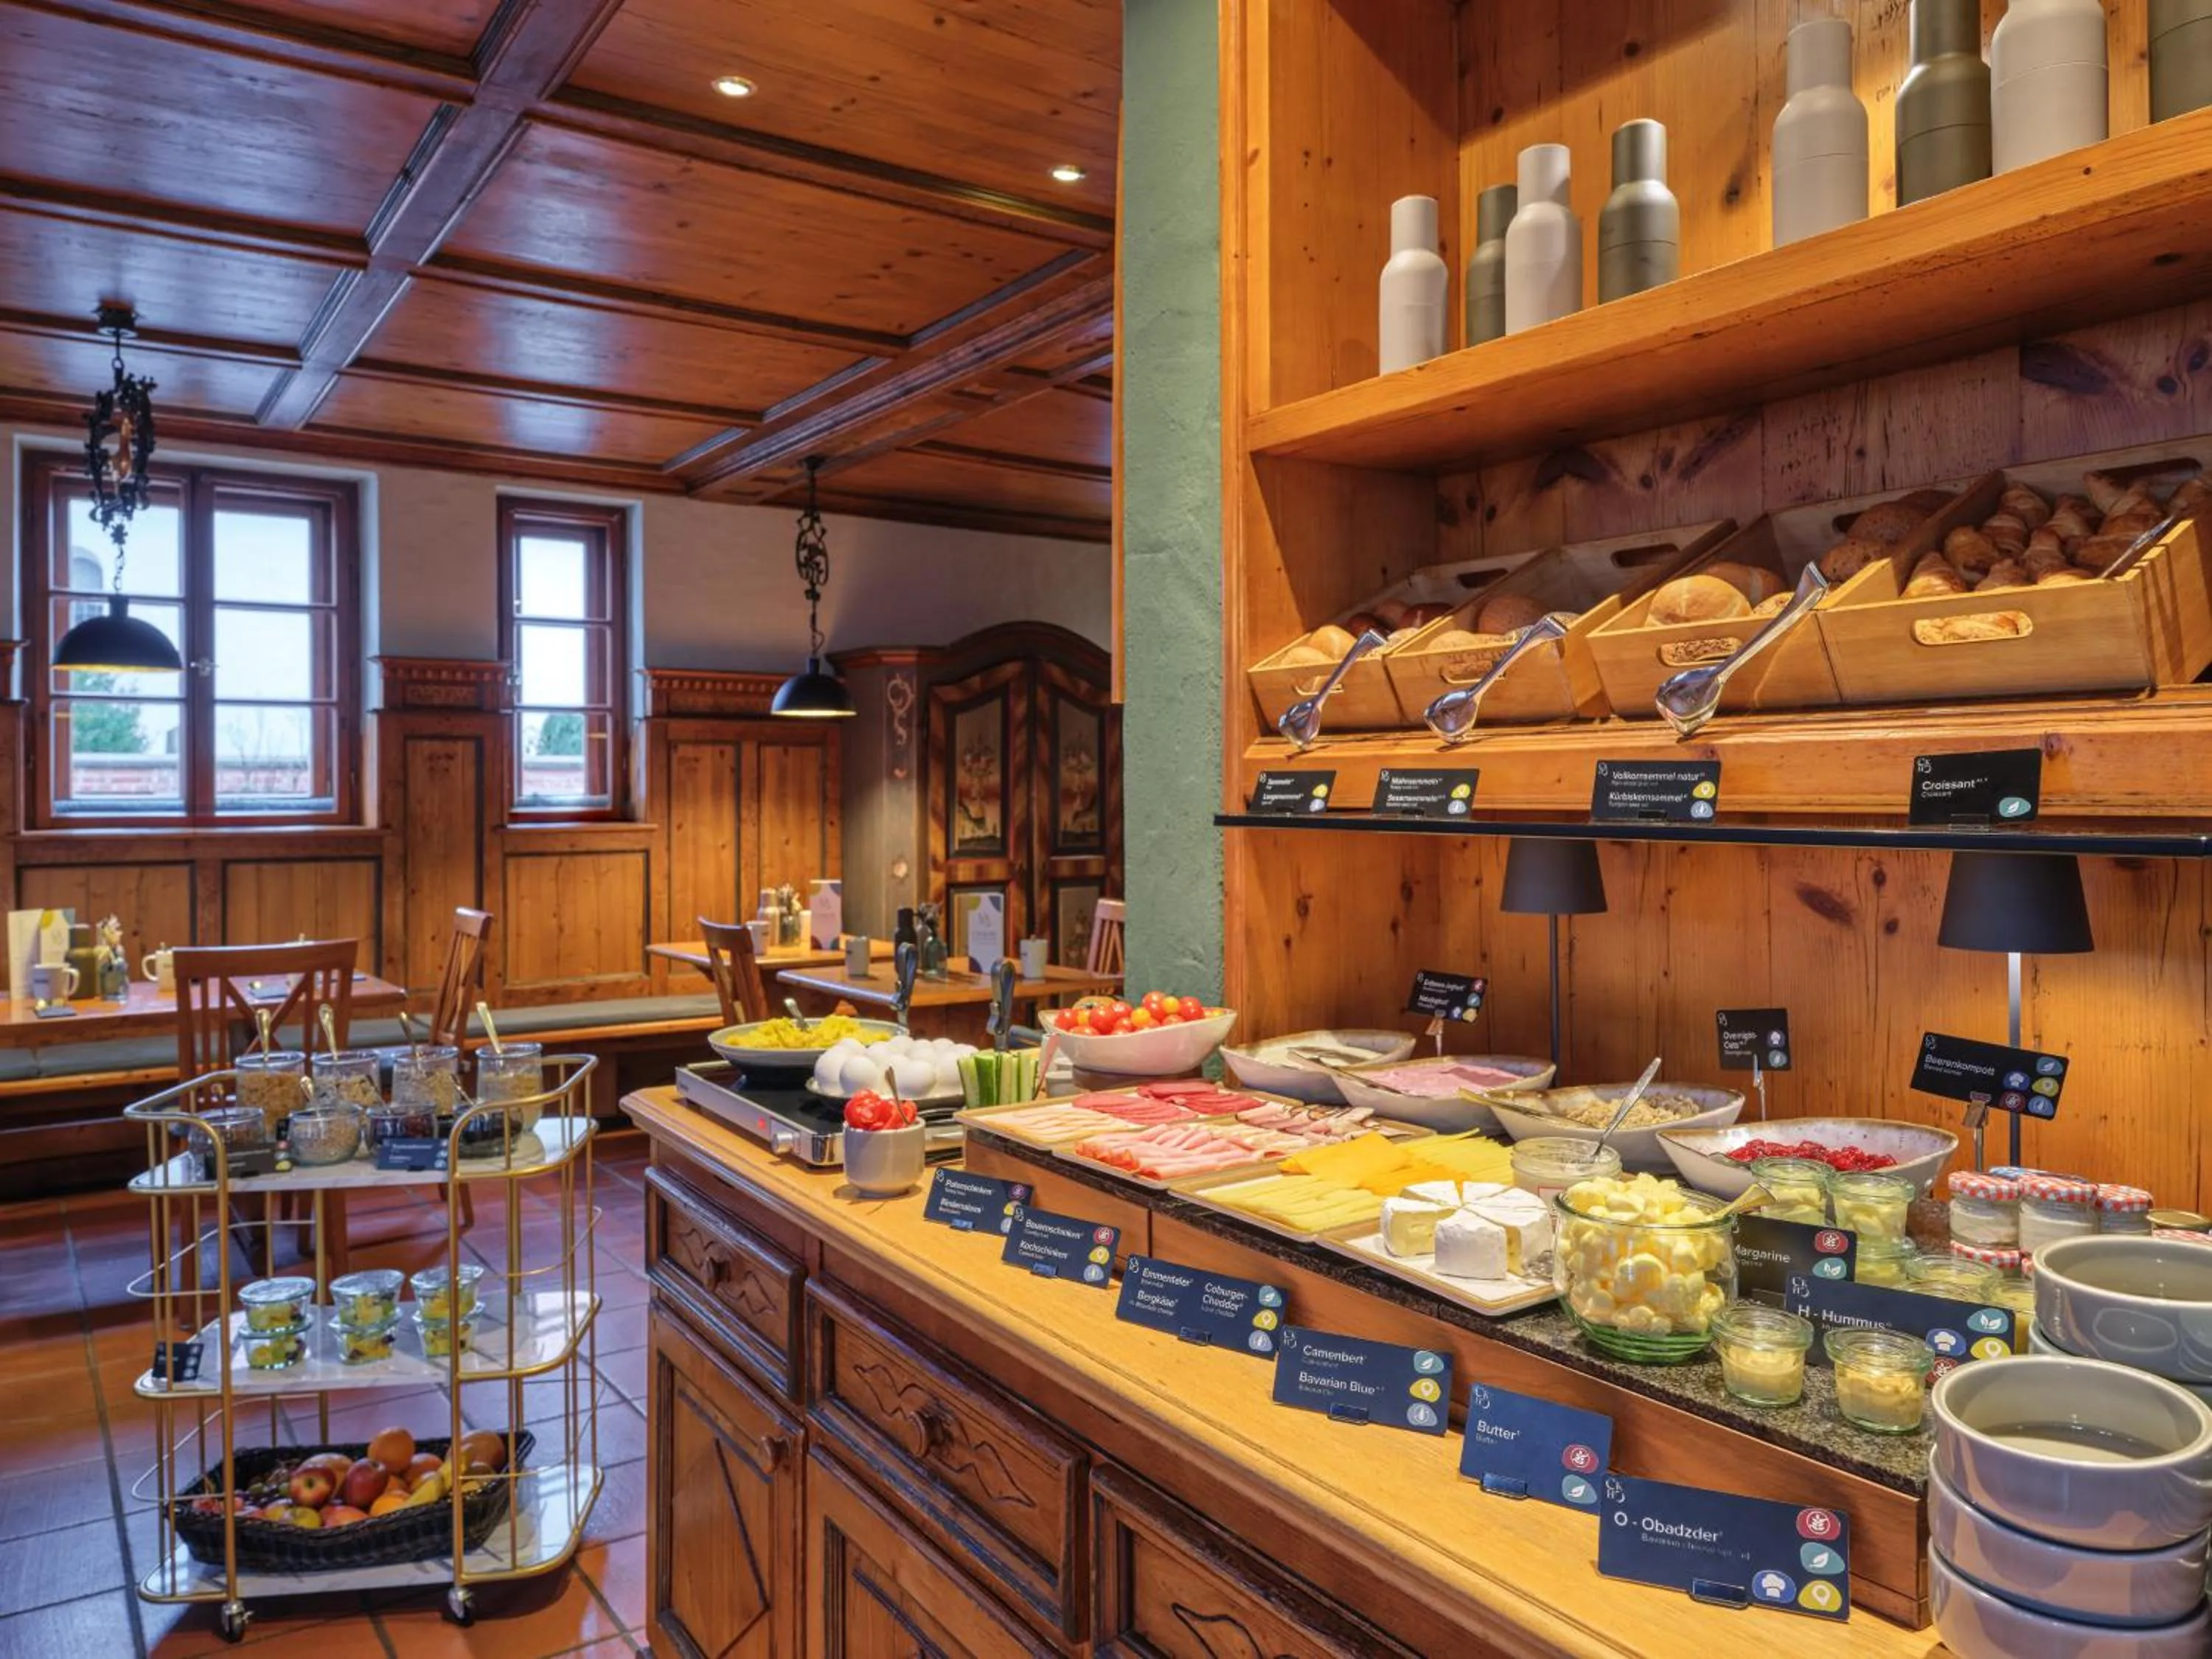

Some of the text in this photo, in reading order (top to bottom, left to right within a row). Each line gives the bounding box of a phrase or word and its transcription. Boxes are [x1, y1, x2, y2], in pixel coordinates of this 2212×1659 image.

[1922, 779, 1975, 790] Croissant
[1924, 1054, 1995, 1076] Beerenkompott
[1798, 1305, 1811, 1317] H
[1822, 1310, 1885, 1329] Hummus
[1298, 1371, 1347, 1390] Bavarian
[1349, 1381, 1375, 1395] Blue
[1477, 1419, 1516, 1440] Butter
[1614, 1511, 1628, 1527] O
[1642, 1517, 1719, 1543] Obadzder
